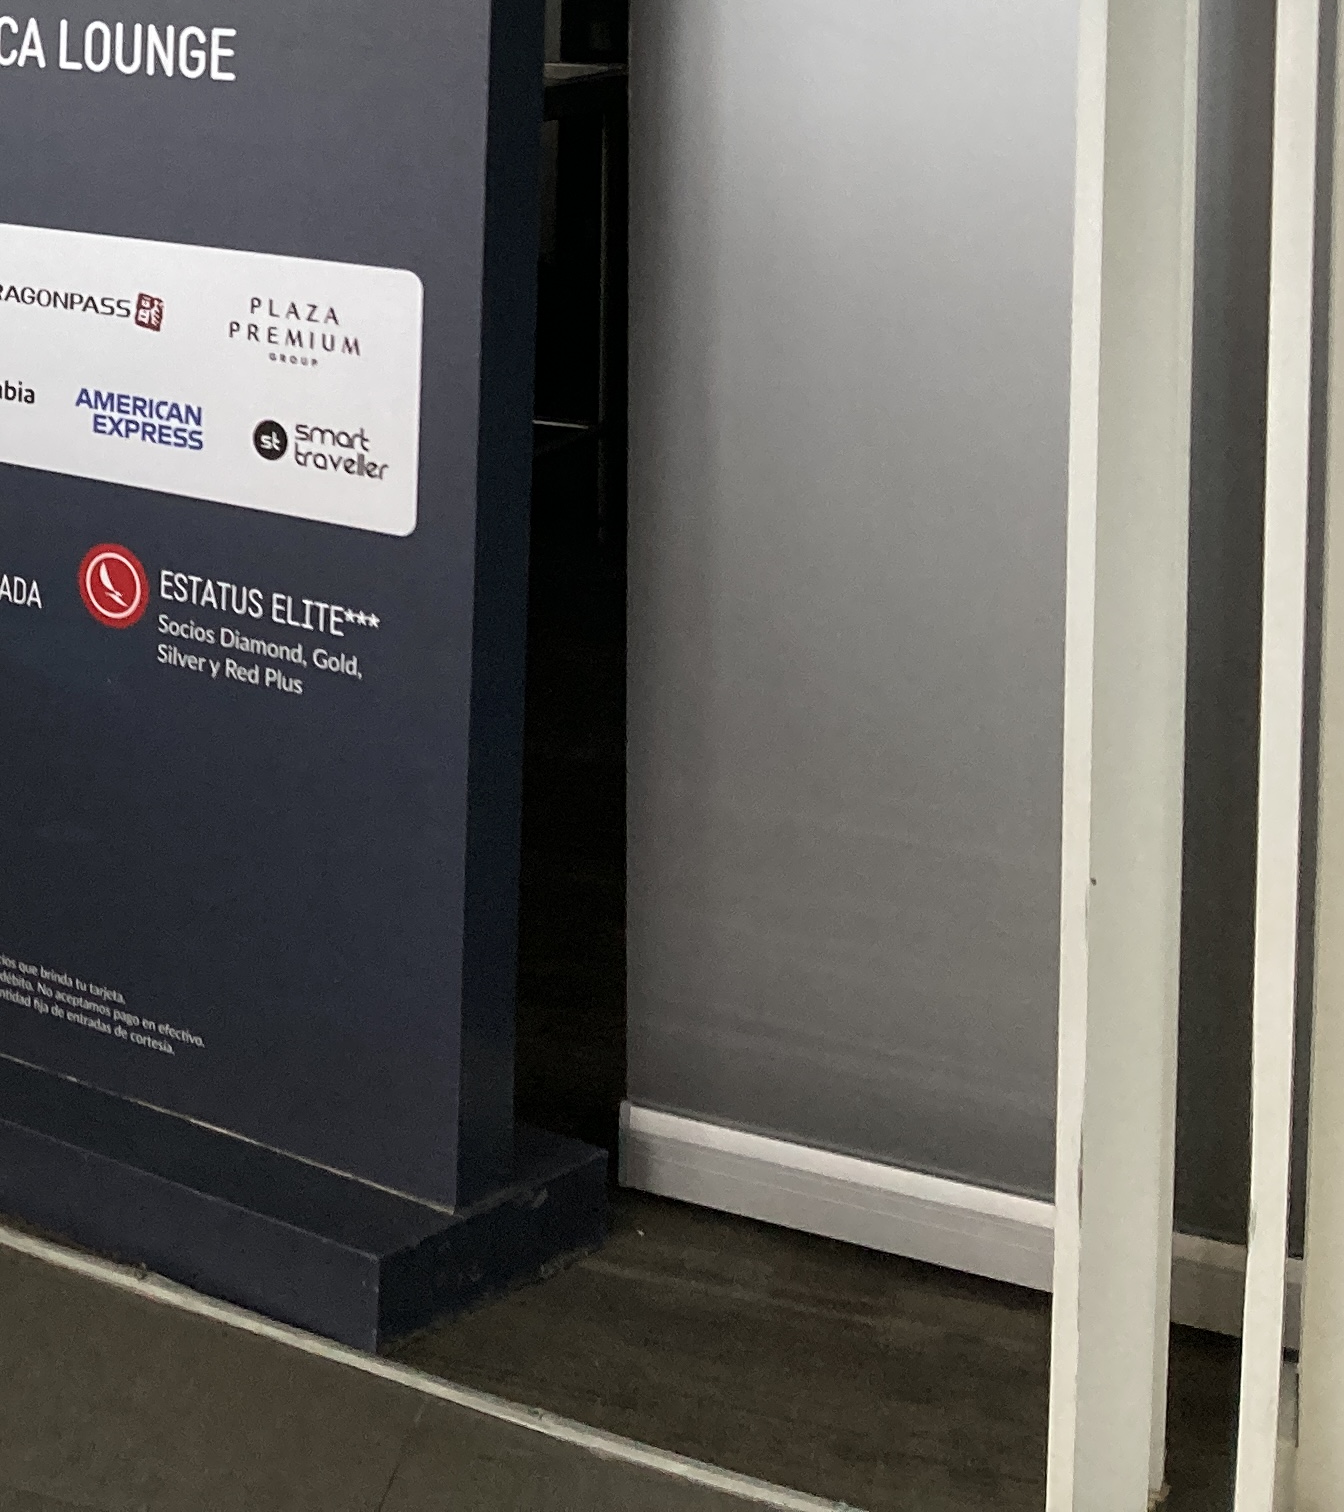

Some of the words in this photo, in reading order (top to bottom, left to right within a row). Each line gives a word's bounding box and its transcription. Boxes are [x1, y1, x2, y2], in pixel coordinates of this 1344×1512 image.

[59, 18, 237, 81] LOUNGE
[250, 297, 340, 326] PLAZA
[228, 321, 362, 357] PREMIUM
[269, 352, 319, 367] GROUP
[75, 387, 203, 427] AMERICAN
[92, 413, 204, 450] EXPRESS
[294, 423, 370, 452] smart
[294, 444, 390, 480] traveller
[160, 569, 263, 619] ESTATUS
[158, 614, 215, 645] Socios
[220, 627, 308, 667] Diamond,
[312, 648, 363, 680] Gold,
[157, 643, 206, 673] Silver
[208, 659, 221, 679] y
[224, 657, 259, 685] Red
[265, 667, 303, 695] Plus
[18, 961, 39, 977] que
[37, 981, 53, 998] No
[113, 1009, 140, 1026] pago
[141, 1018, 156, 1031] en
[51, 1003, 65, 1018] de
[66, 1010, 112, 1035] entradas
[113, 1025, 128, 1039] de
